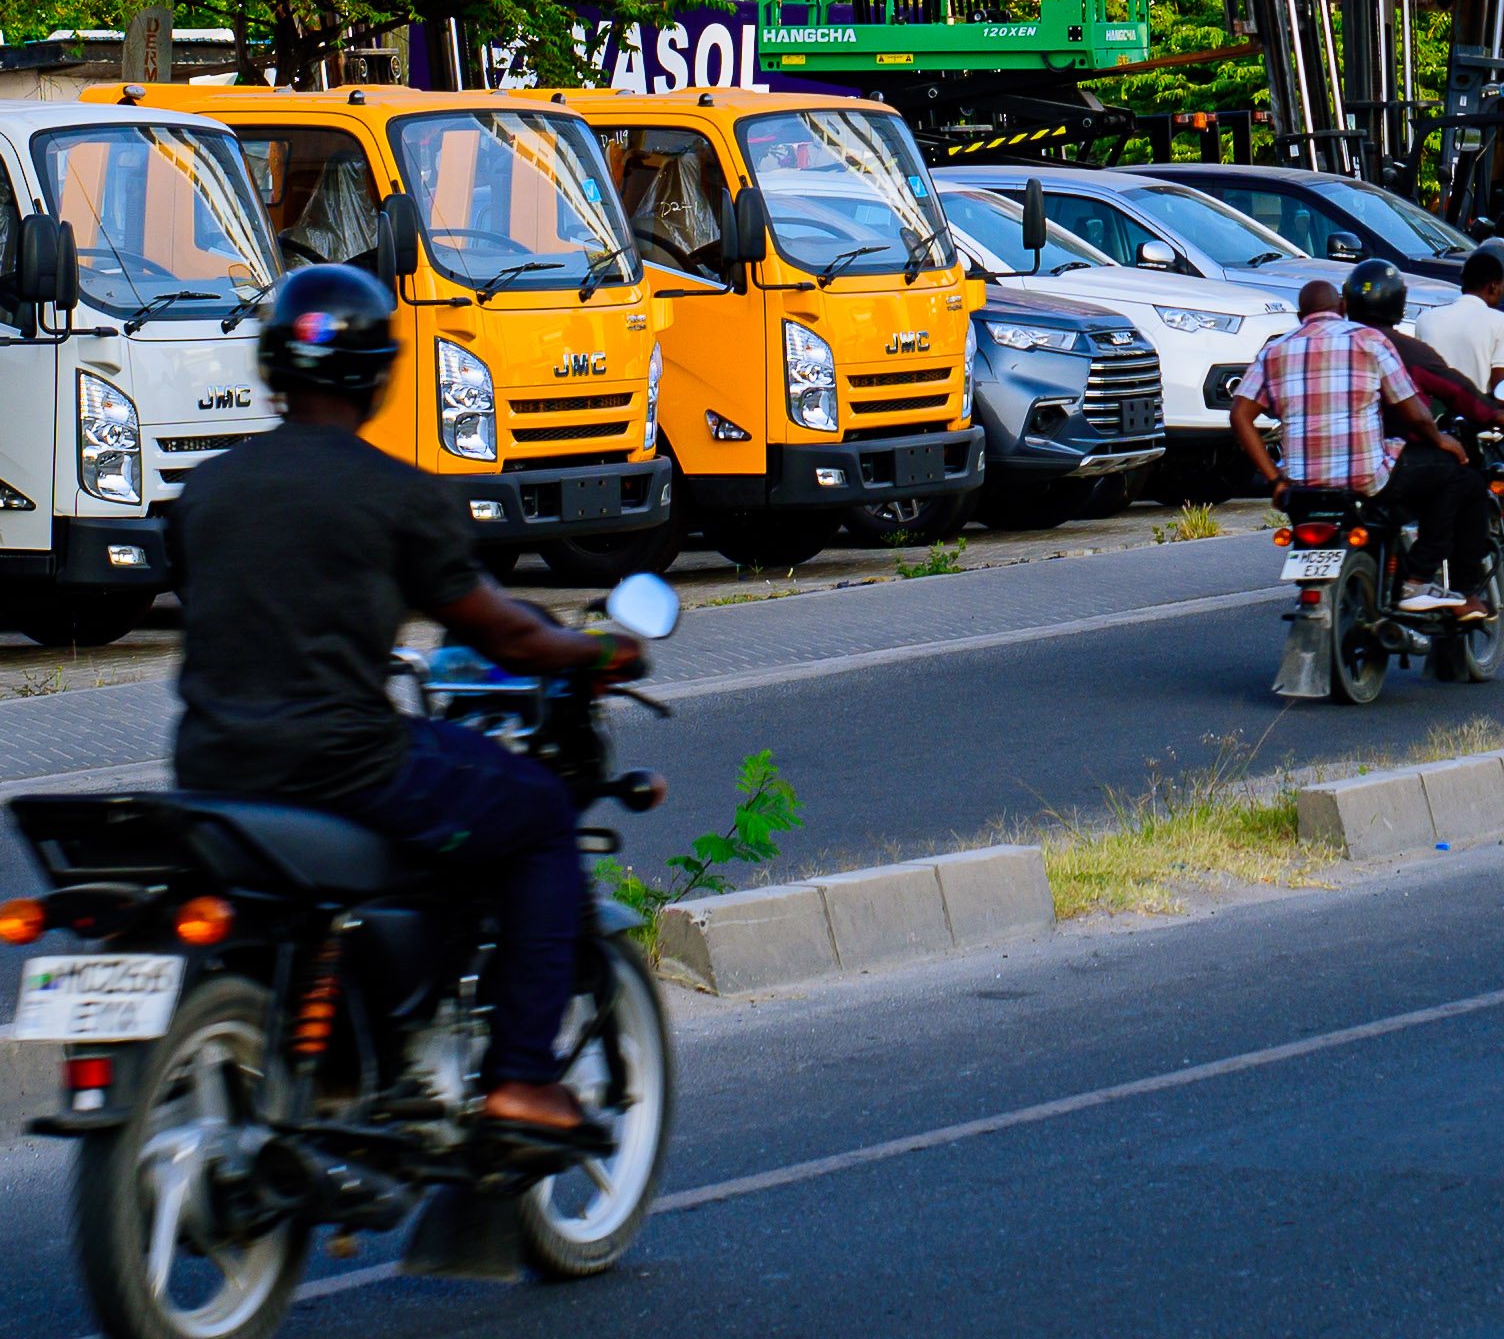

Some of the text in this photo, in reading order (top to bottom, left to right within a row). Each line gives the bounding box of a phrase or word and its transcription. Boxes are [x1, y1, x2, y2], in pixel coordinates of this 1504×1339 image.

[761, 25, 1038, 44] HANGCHA 120XEN
[885, 330, 931, 355] JMC
[554, 352, 607, 378] JMC
[197, 383, 252, 410] JMC
